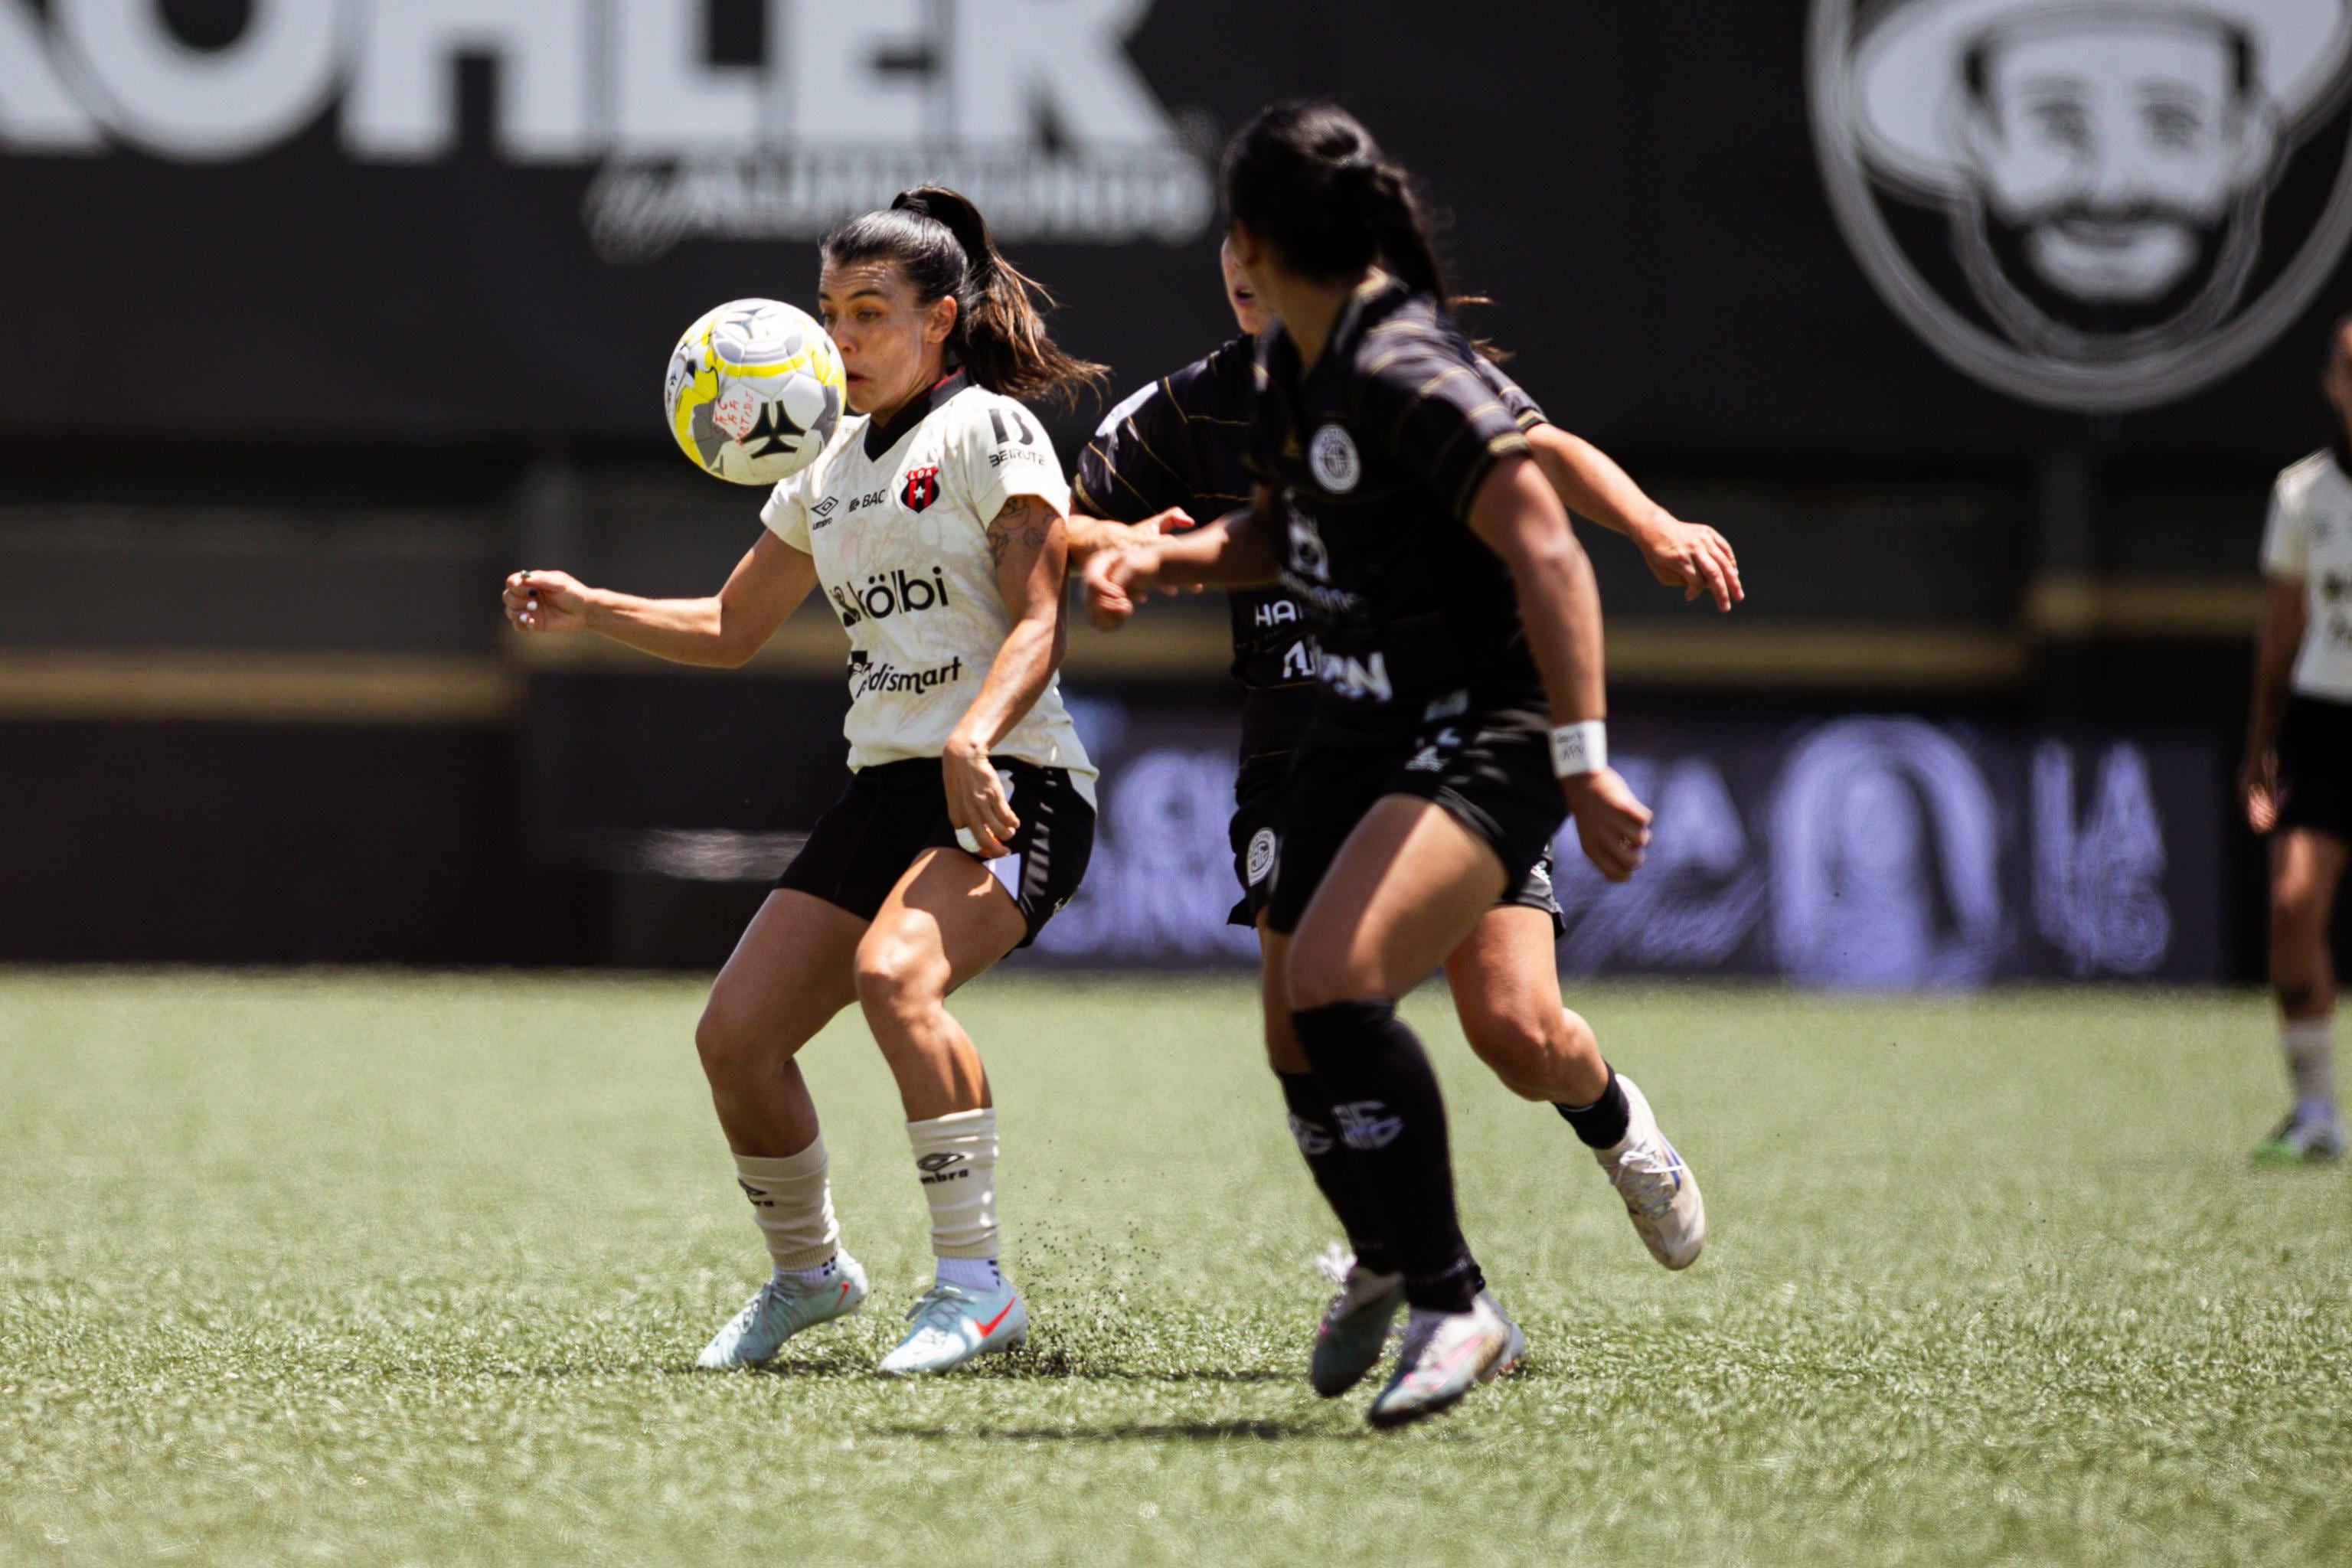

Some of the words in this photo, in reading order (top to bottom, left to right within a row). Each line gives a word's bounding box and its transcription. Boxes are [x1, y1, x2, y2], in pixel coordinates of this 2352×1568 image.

[988, 449, 1045, 468] BEIRUTE
[910, 468, 933, 481] LDA
[862, 489, 886, 508] BAC
